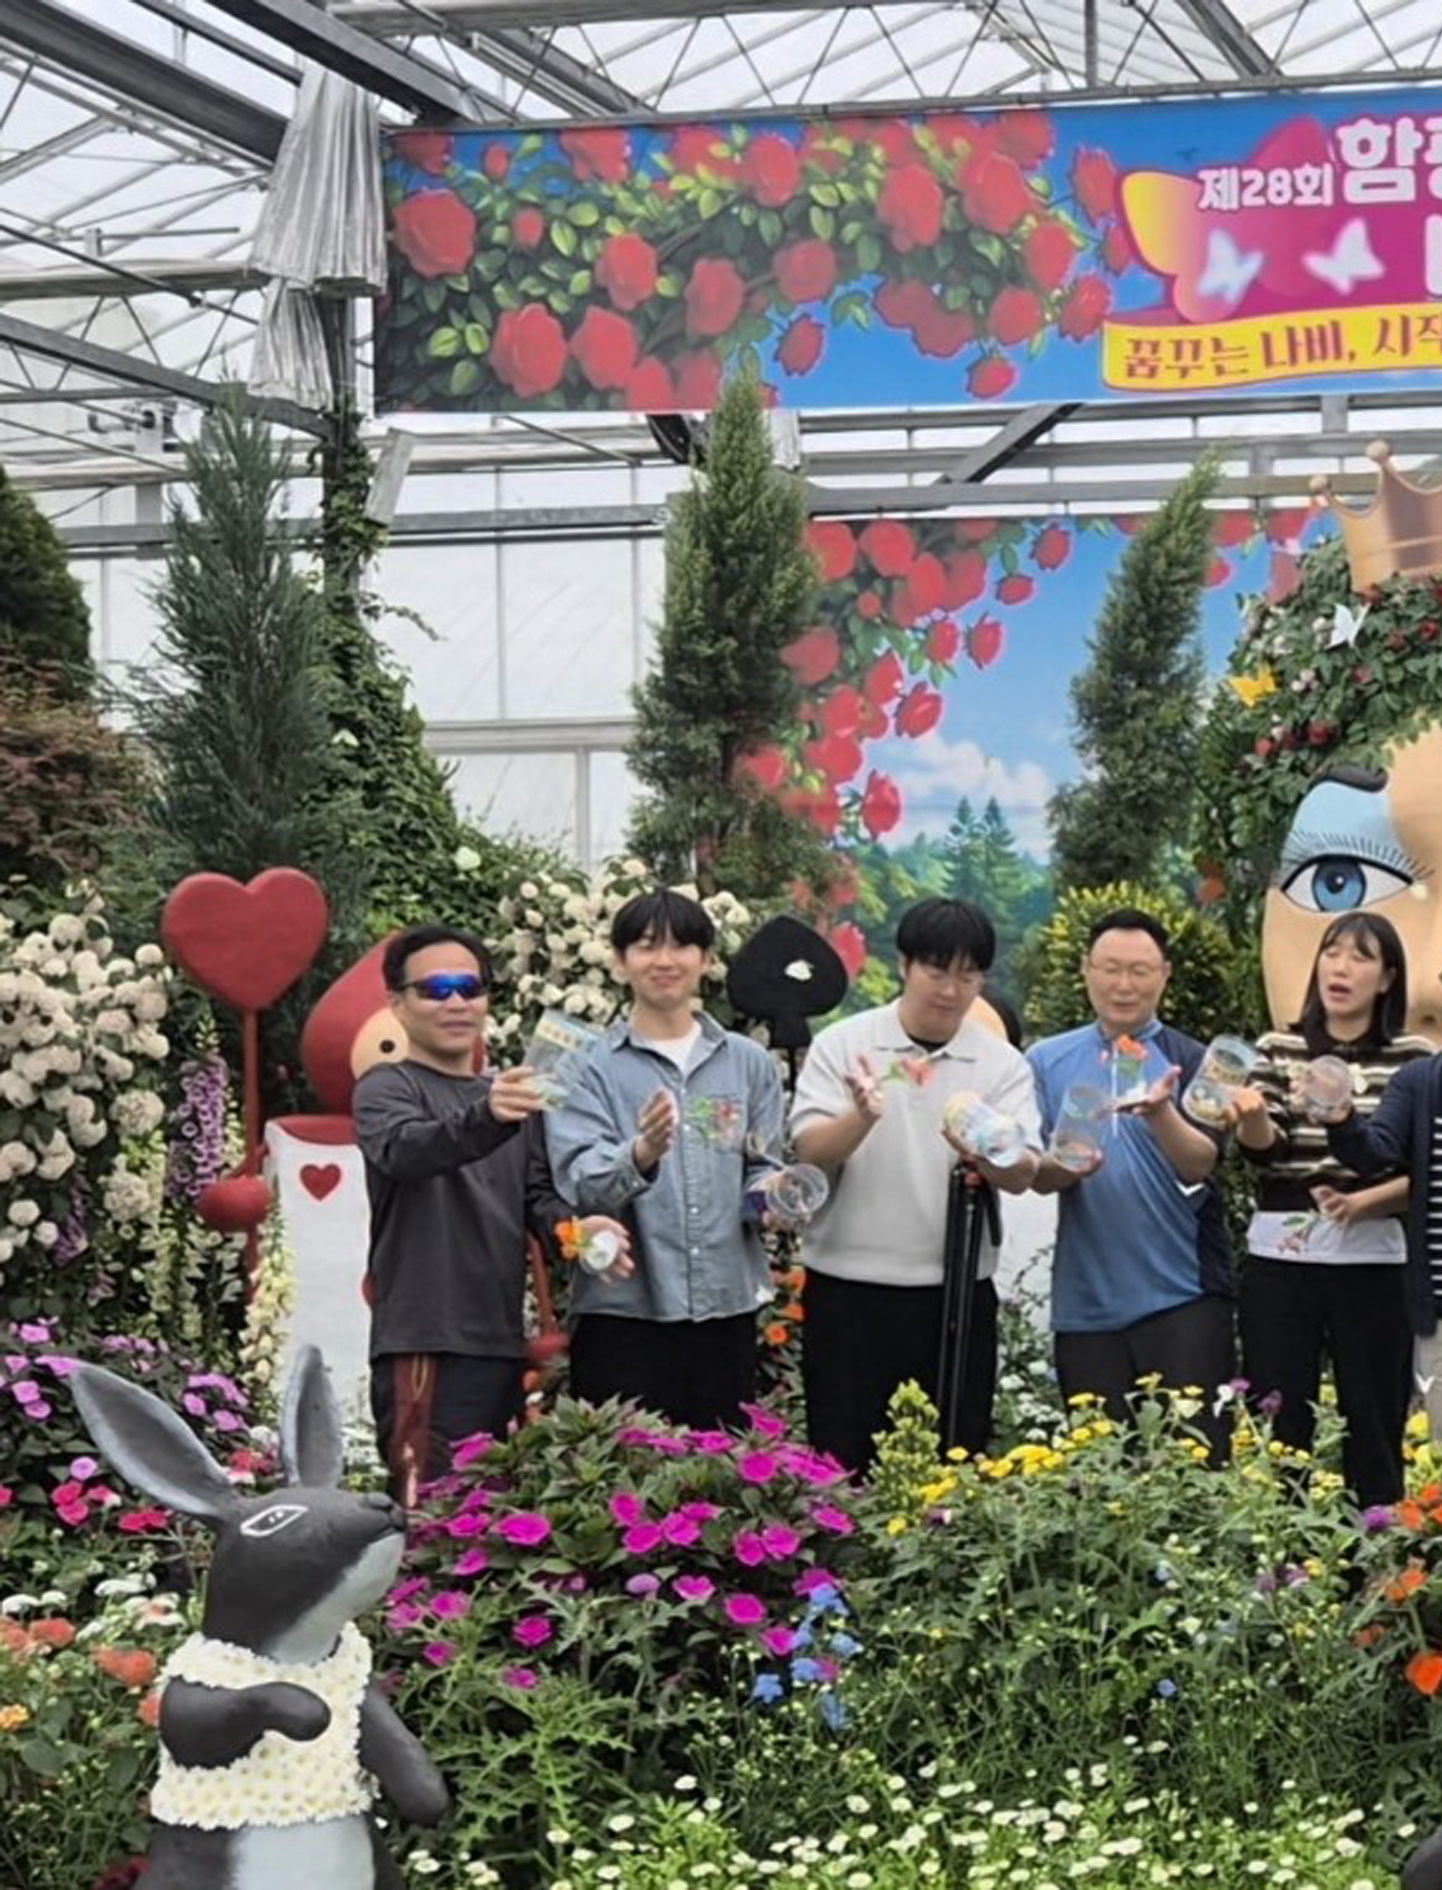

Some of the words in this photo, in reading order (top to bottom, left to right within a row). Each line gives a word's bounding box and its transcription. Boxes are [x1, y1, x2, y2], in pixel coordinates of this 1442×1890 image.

[1197, 163, 1334, 210] 제28회
[1125, 337, 1250, 380] 꿈꾸는
[1260, 319, 1357, 368] 나비,
